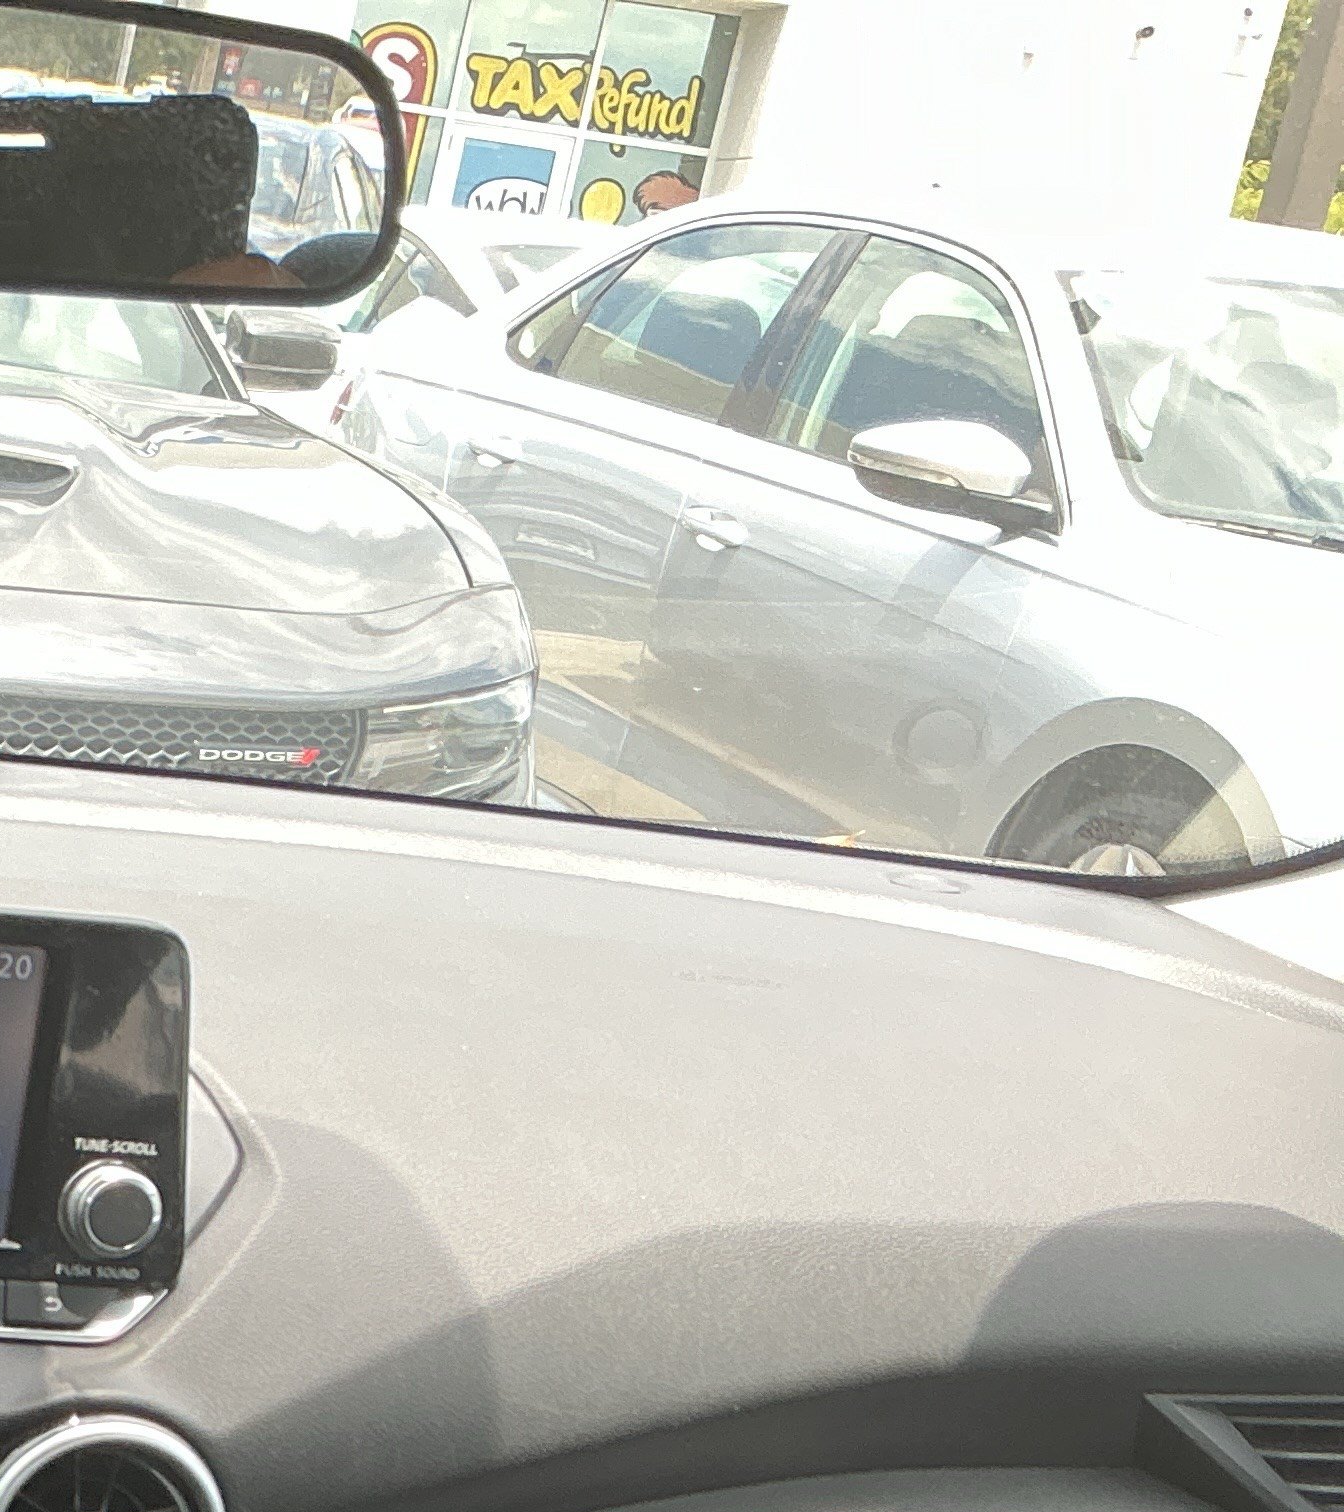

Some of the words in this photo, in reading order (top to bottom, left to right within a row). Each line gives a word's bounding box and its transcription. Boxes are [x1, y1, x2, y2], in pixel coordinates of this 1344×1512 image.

[467, 53, 589, 125] TAX
[583, 62, 704, 157] Refund
[199, 748, 305, 764] DODGE
[54, 1262, 93, 1280] PUSH
[96, 1263, 141, 1282] SOUND
